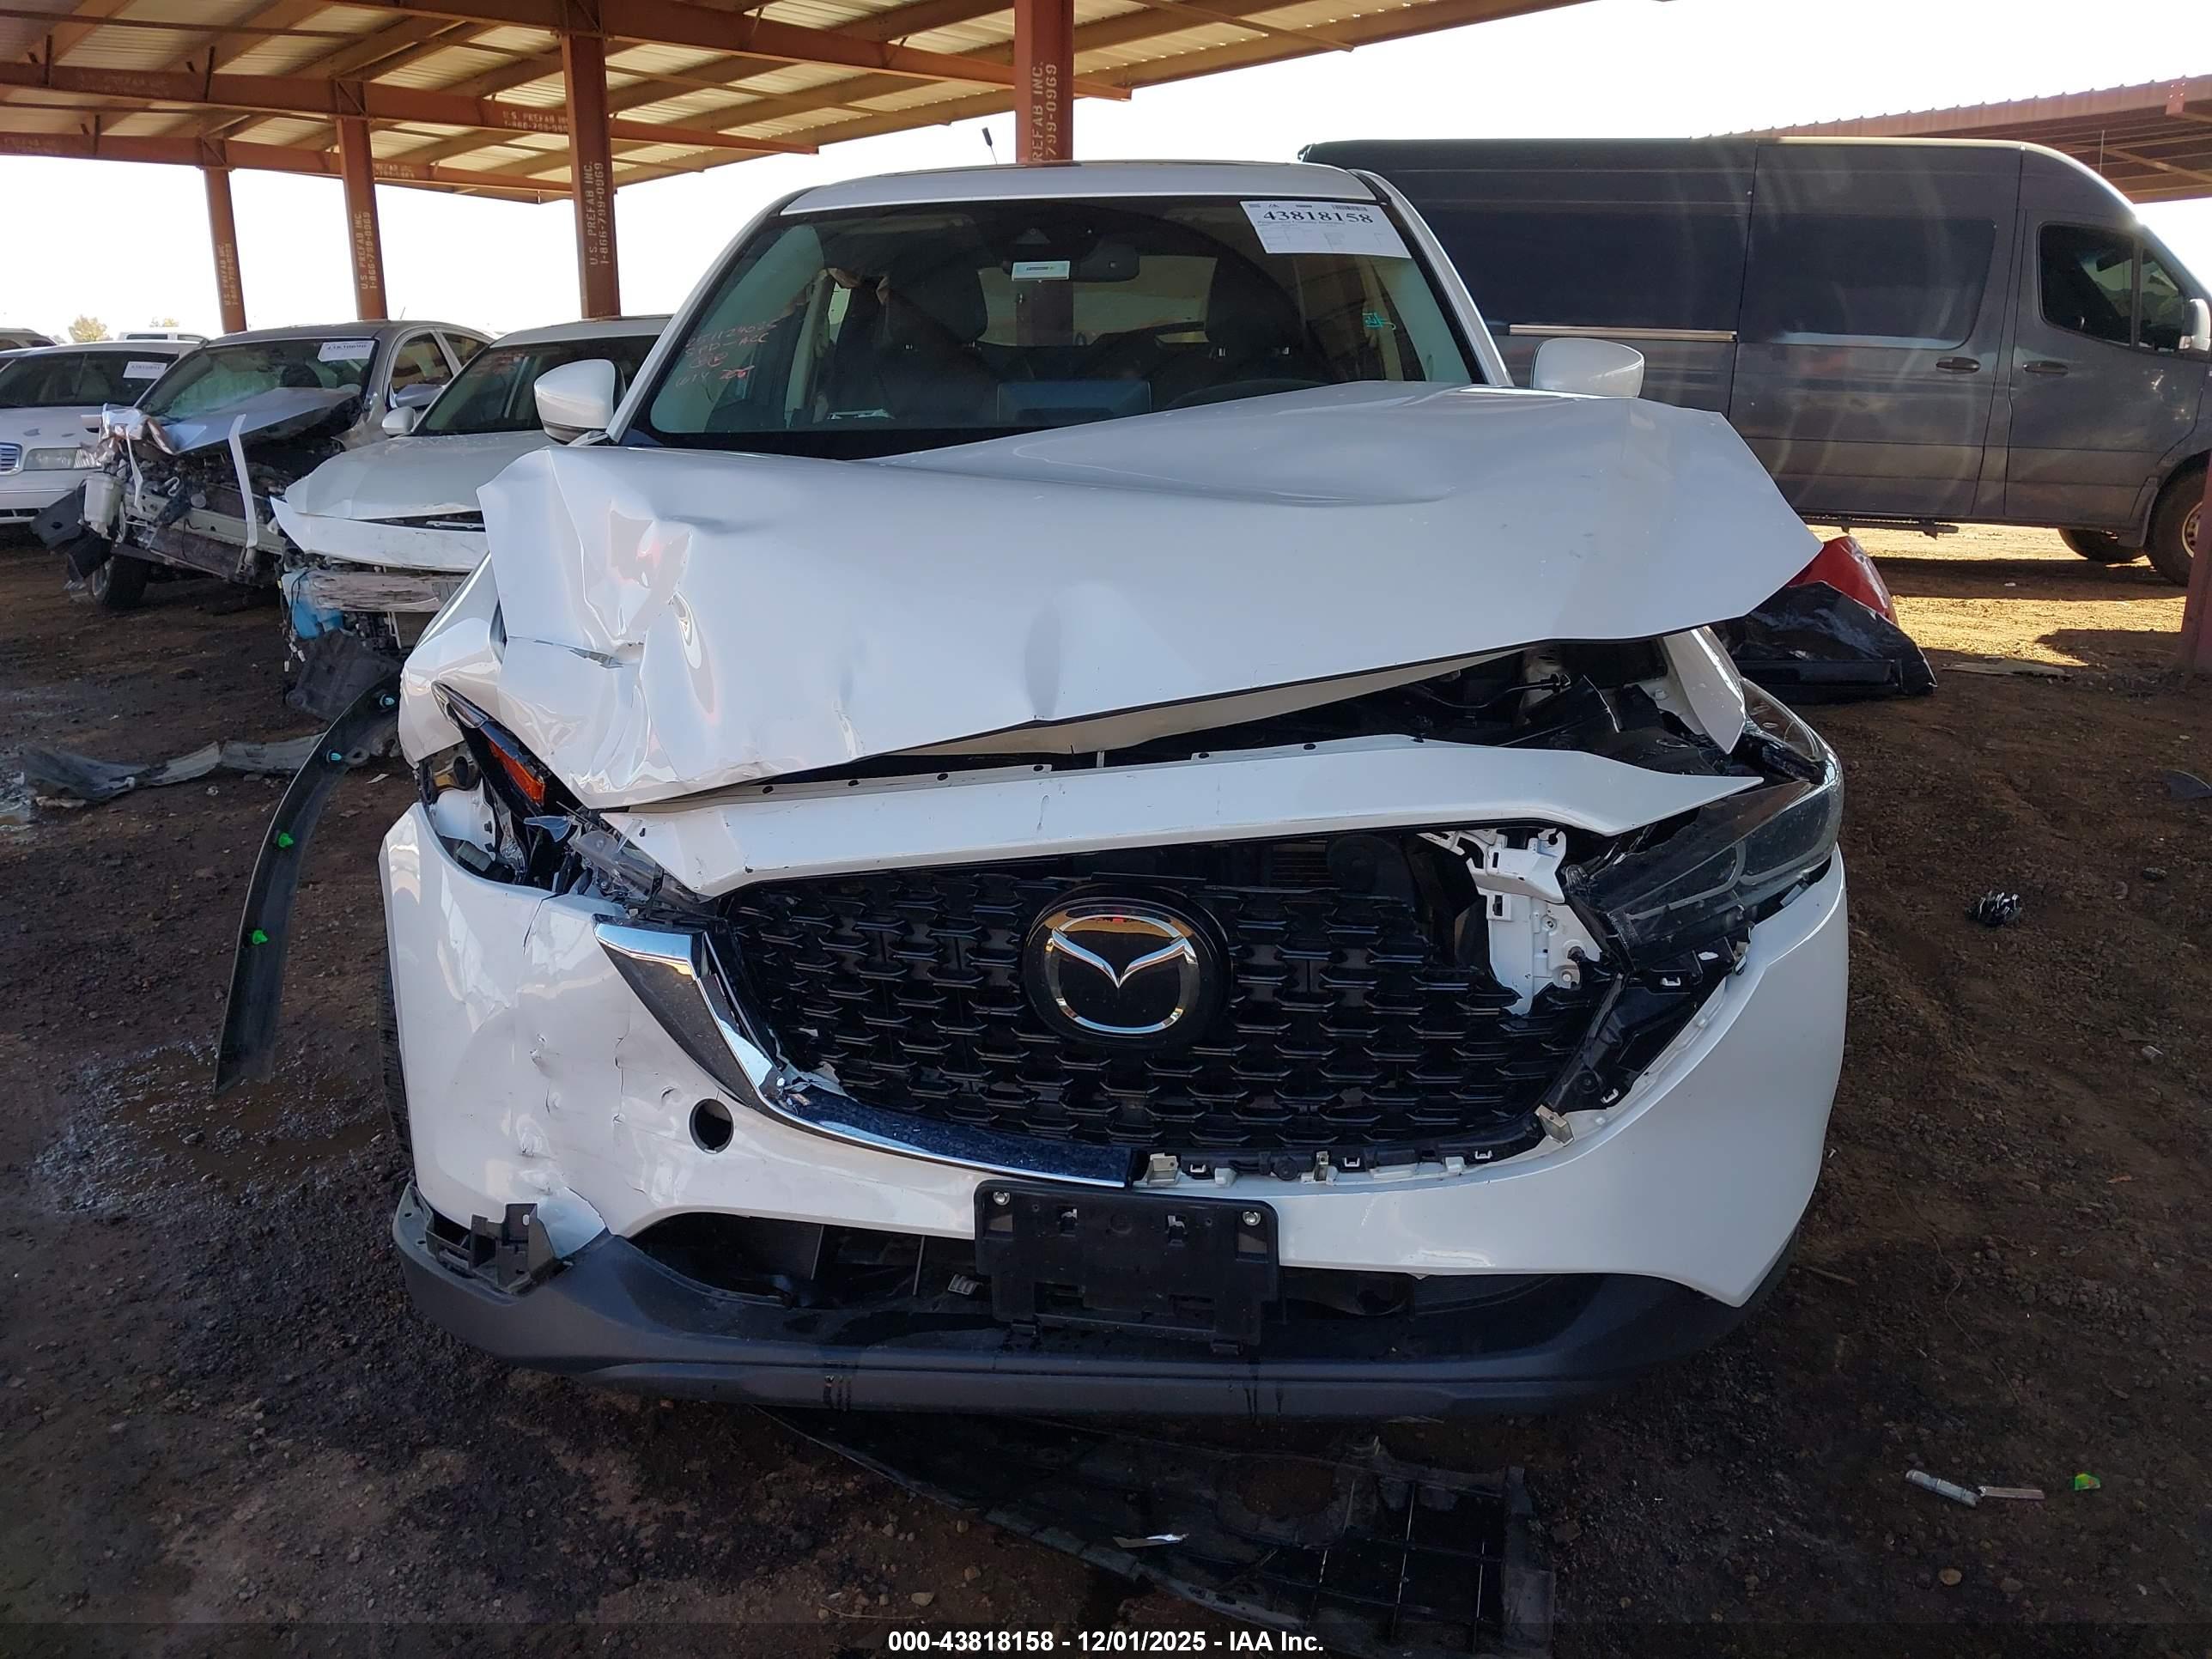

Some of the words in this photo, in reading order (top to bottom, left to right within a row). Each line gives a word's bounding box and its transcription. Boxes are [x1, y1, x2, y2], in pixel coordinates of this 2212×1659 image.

[1032, 61, 1044, 95] INC.
[1031, 104, 1043, 162] REFAB
[584, 161, 594, 184] INC.
[585, 191, 597, 236] PREFAB
[1263, 210, 1374, 224] 43818158
